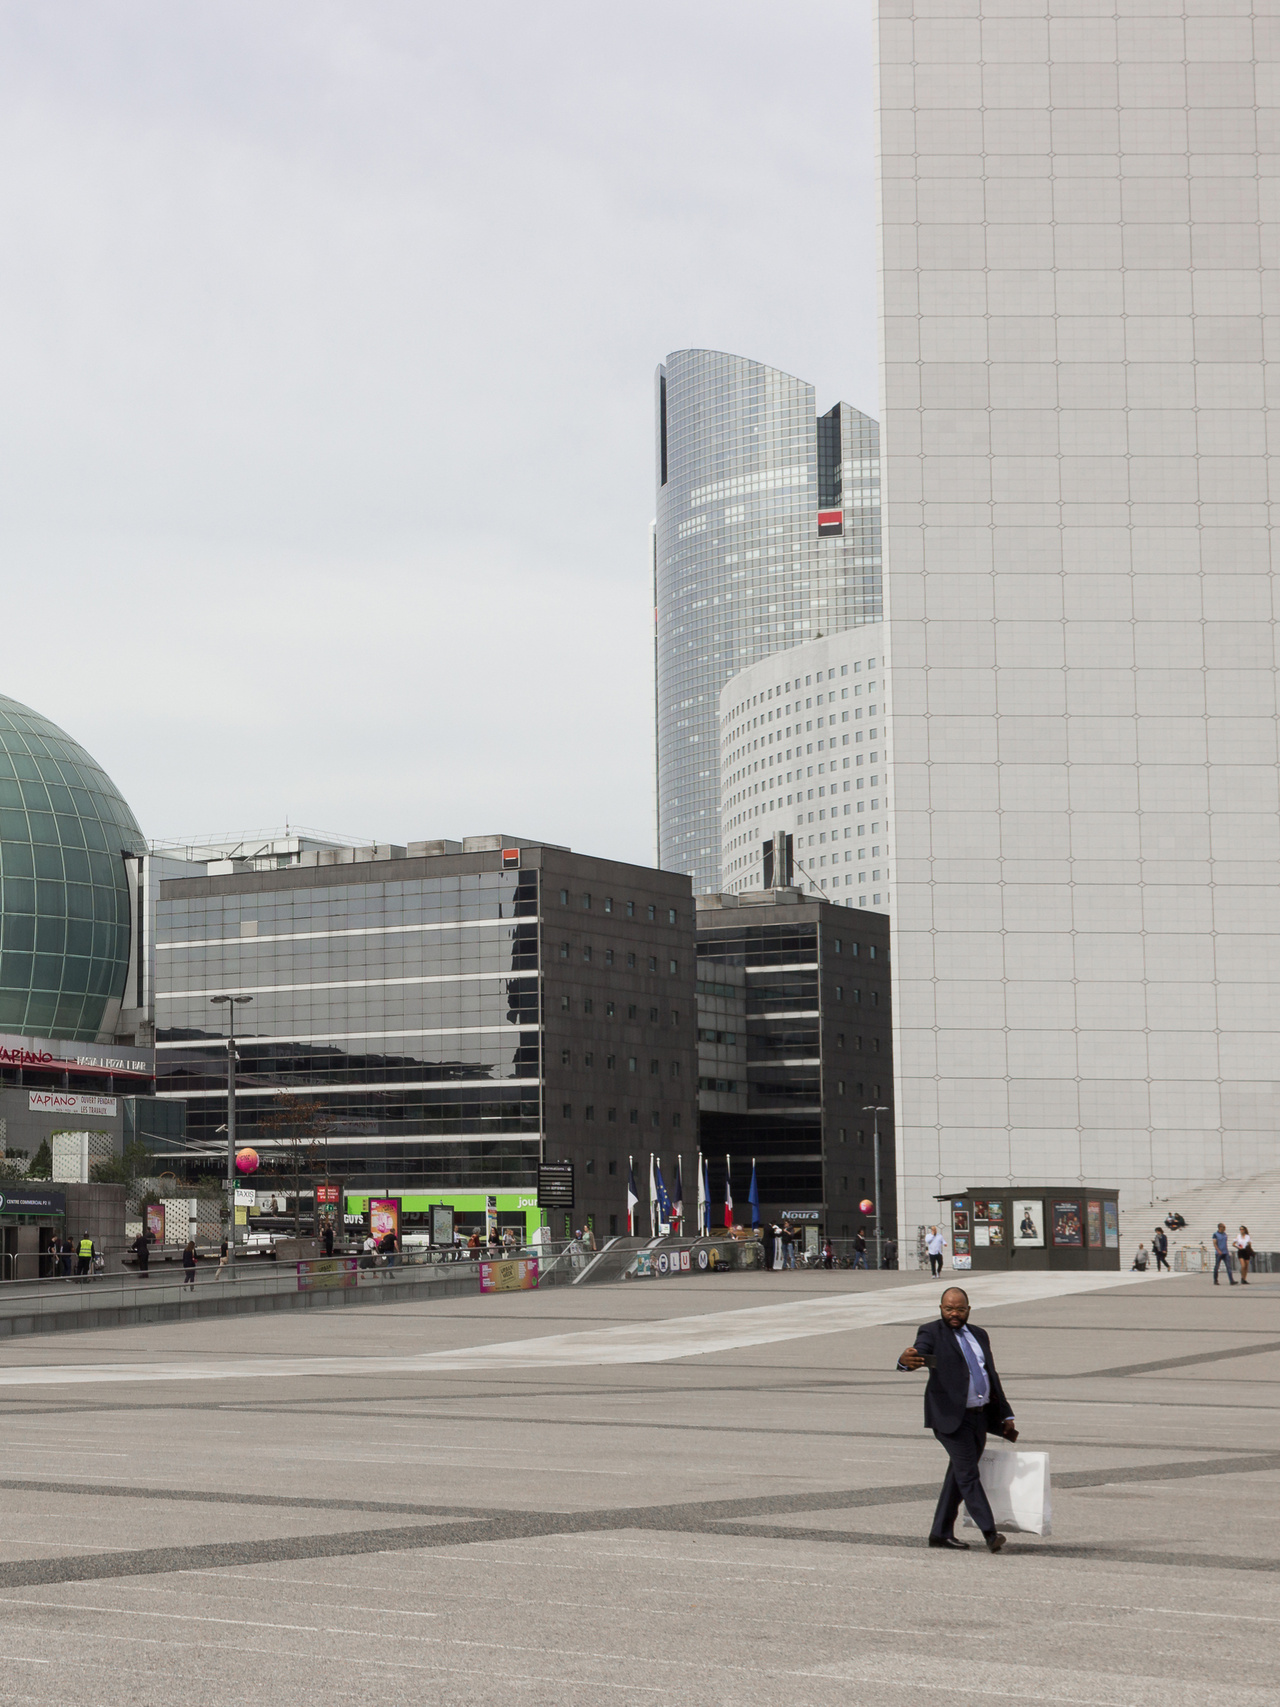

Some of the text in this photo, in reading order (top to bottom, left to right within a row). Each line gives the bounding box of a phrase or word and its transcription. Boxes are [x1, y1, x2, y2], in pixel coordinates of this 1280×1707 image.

[132, 1061, 147, 1071] BAR
[81, 1096, 115, 1106] OUVERT PENDANT
[89, 1106, 107, 1115] TRAVAUX
[236, 1190, 255, 1198] TAXIS
[343, 1214, 364, 1224] GUYS
[781, 1210, 819, 1219] Noura
